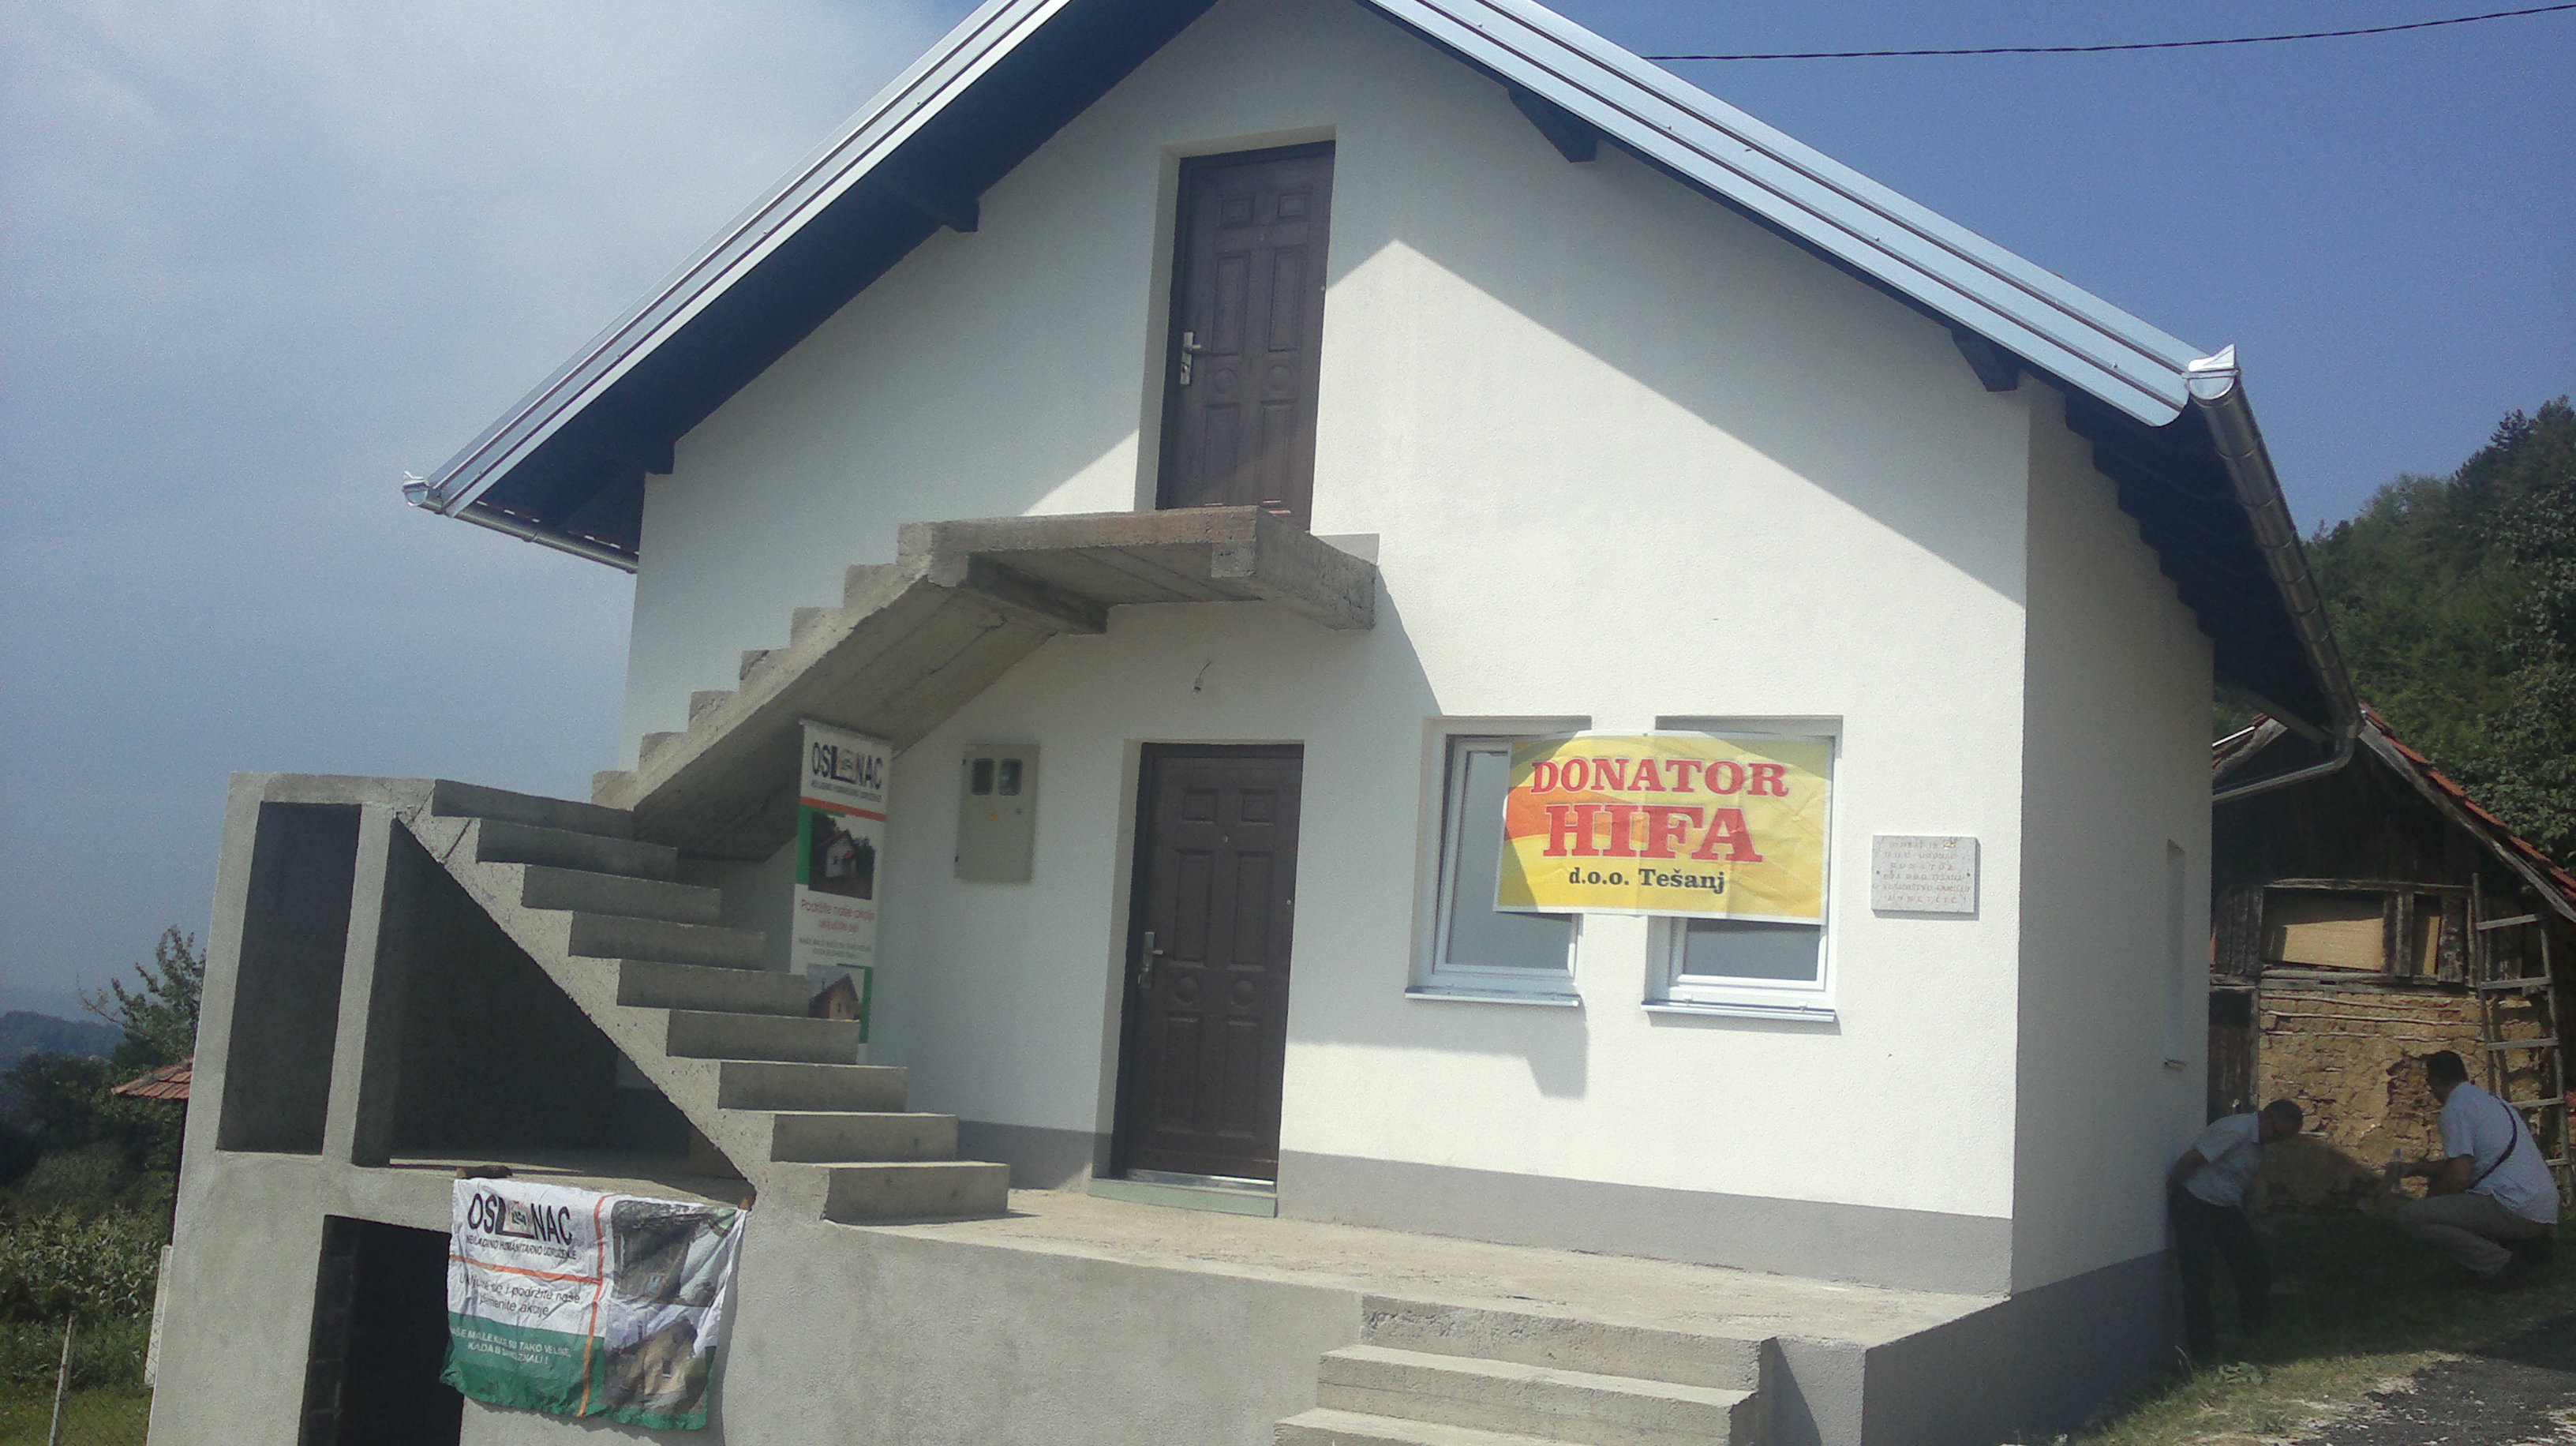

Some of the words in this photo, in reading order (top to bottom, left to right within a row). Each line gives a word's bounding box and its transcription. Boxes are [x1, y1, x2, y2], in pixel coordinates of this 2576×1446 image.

[1530, 757, 1790, 797] DONATOR
[1543, 804, 1764, 863] HIFA
[1569, 867, 1630, 886] d.o.o.
[1638, 868, 1725, 895] Tešanj
[519, 1341, 542, 1353] TAKO
